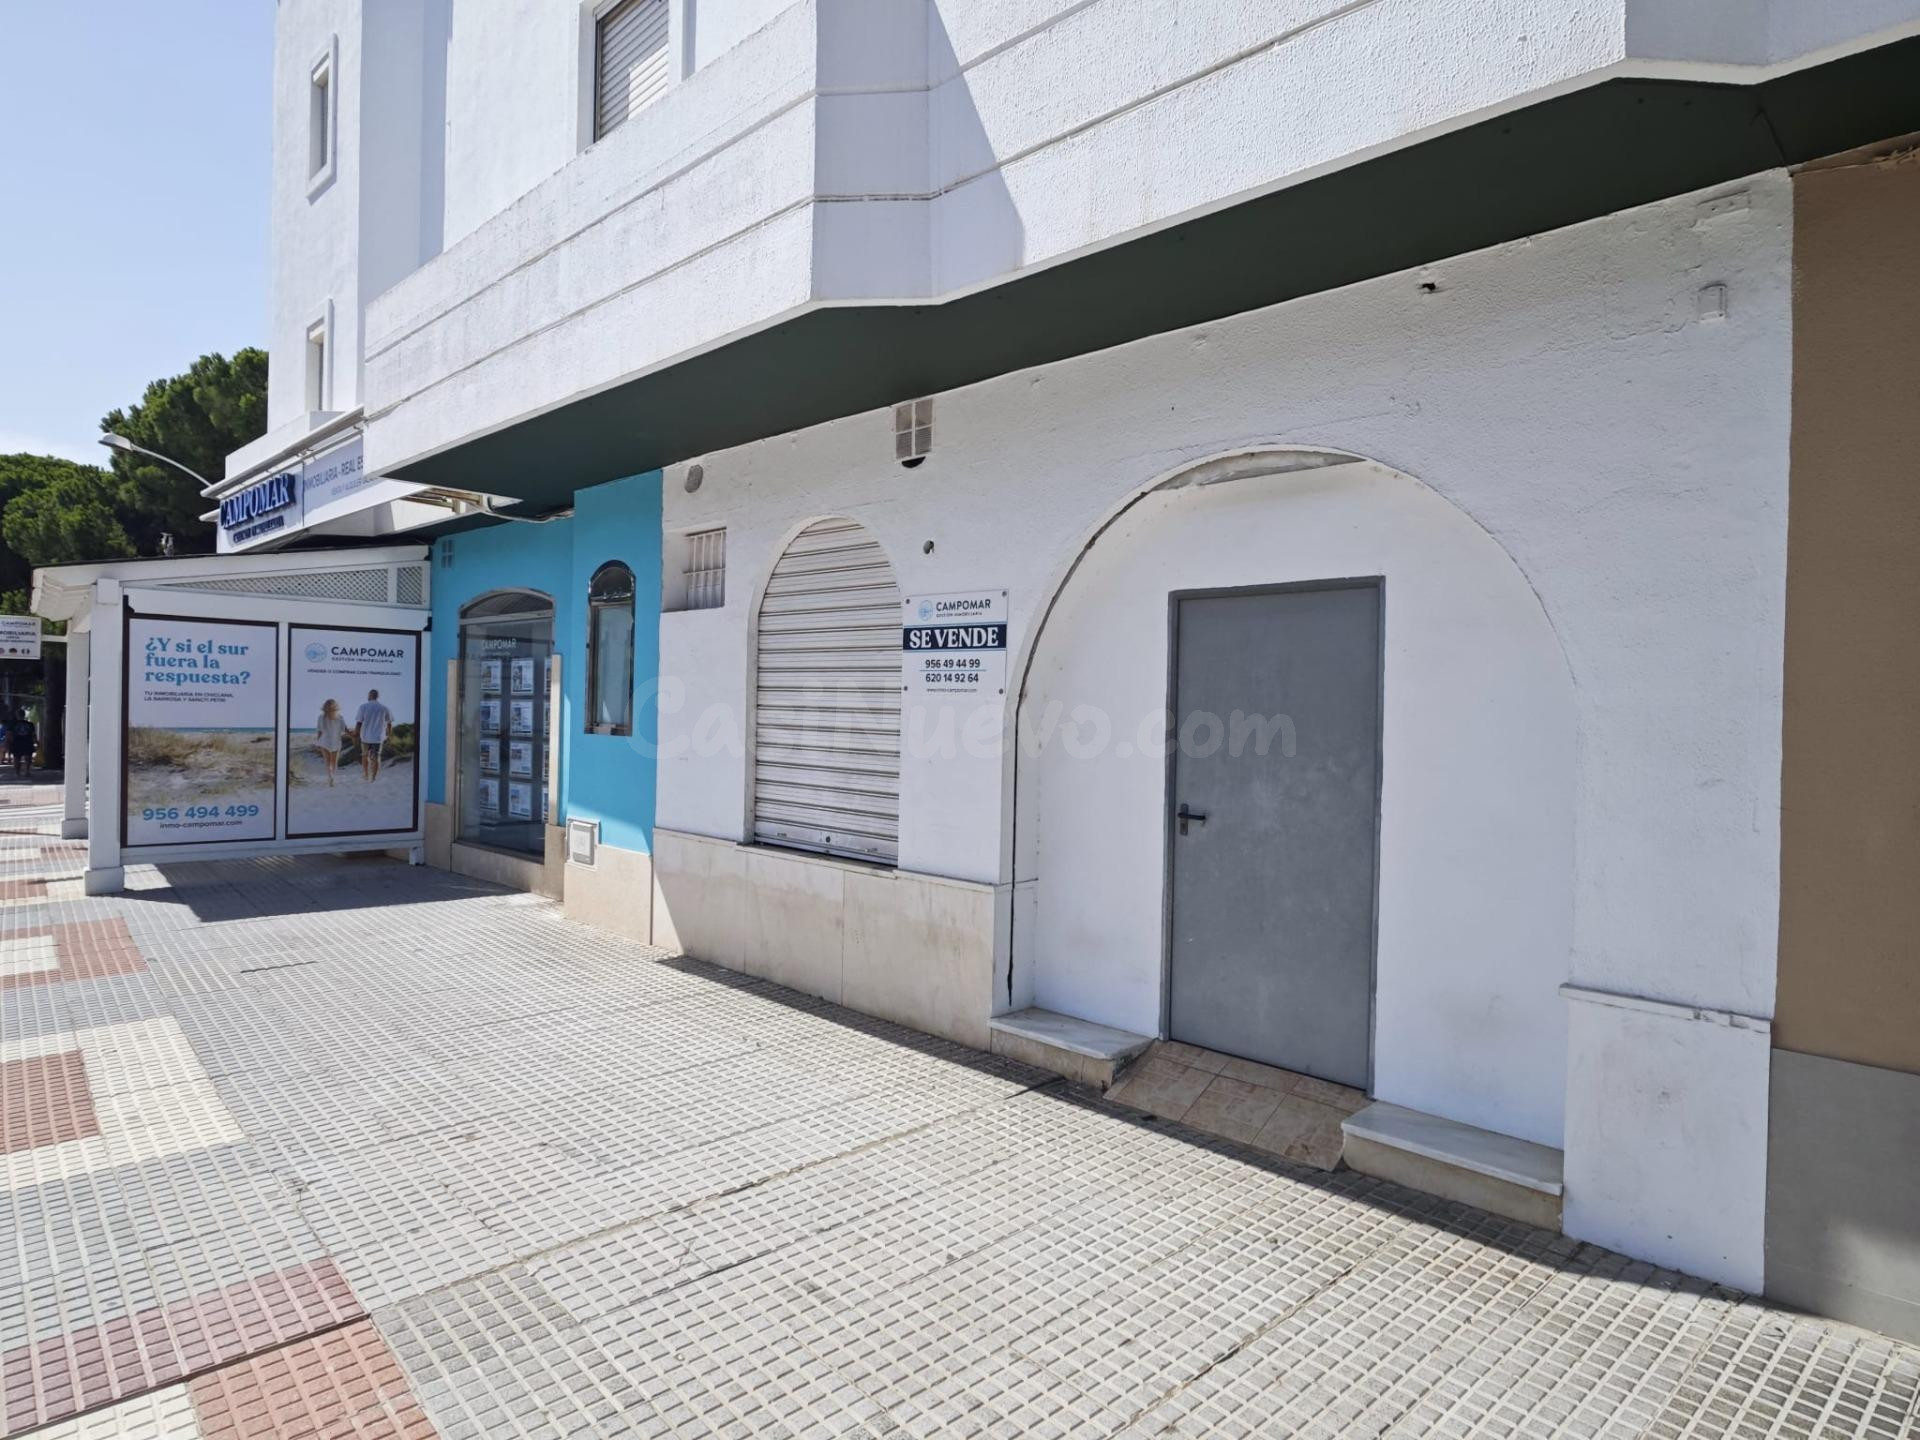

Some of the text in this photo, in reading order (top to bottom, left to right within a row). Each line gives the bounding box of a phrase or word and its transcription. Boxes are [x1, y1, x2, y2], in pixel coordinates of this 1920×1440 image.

[220, 473, 294, 529] CAMPOMAR
[936, 599, 991, 612] CAMPOMAR
[909, 627, 999, 649] SE VENDE
[145, 637, 249, 656] ¿Y si el sur
[331, 646, 405, 659] CAMPOMAR
[145, 652, 220, 669] fuera la
[925, 659, 981, 669] 956 49 44 99
[144, 671, 251, 686] respuesta?
[925, 673, 979, 683] 620 14 92 64
[143, 804, 259, 821] 956 494 499
[160, 820, 243, 829] inmo-campomar.com
